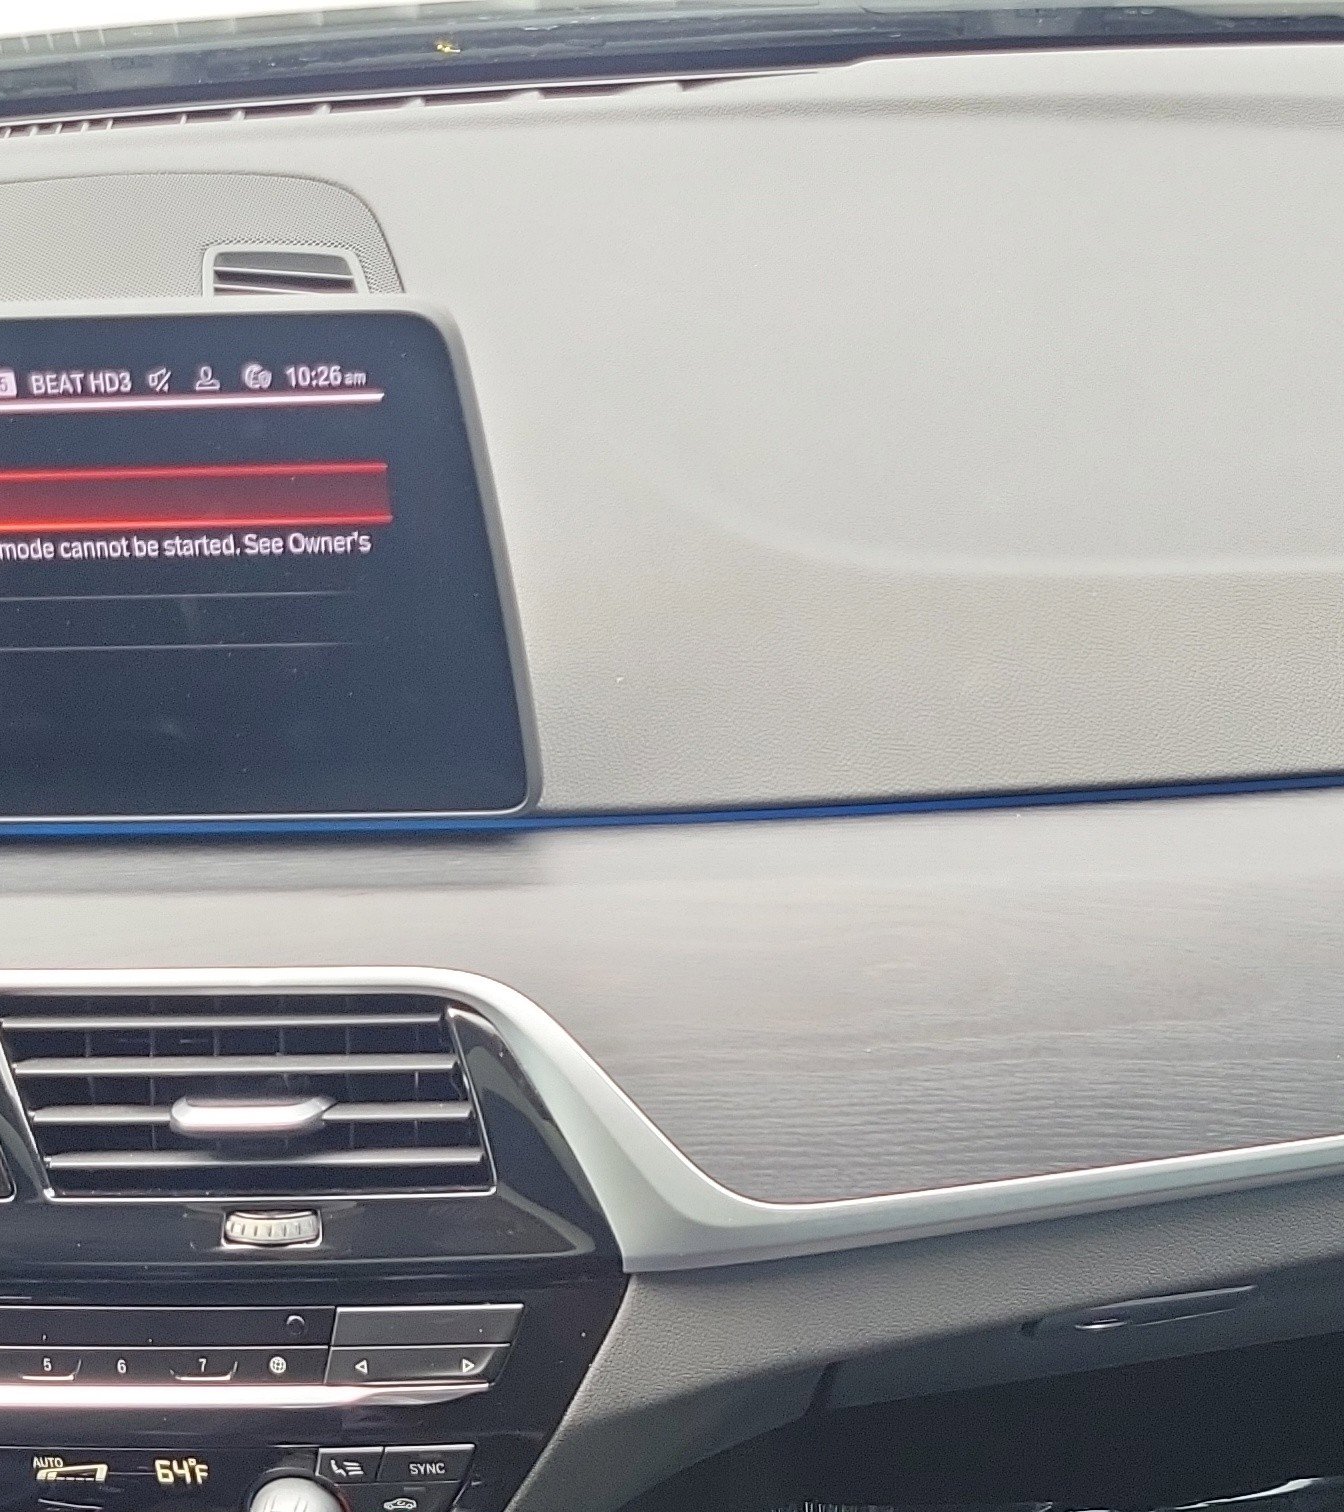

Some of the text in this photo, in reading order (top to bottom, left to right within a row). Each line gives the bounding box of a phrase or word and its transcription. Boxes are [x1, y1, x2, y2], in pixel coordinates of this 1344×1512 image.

[31, 372, 84, 394] BEAT
[89, 372, 132, 393] HD3
[0, 538, 55, 561] mode
[58, 537, 130, 560] cannot
[133, 535, 159, 557] be
[163, 534, 241, 558] started.
[244, 532, 283, 555] See
[288, 530, 372, 555] Owner's
[42, 1357, 53, 1373] 5
[116, 1358, 127, 1375] 6
[197, 1357, 208, 1373] 7
[32, 1456, 64, 1470] AUTO
[409, 1462, 446, 1476] SYNC
